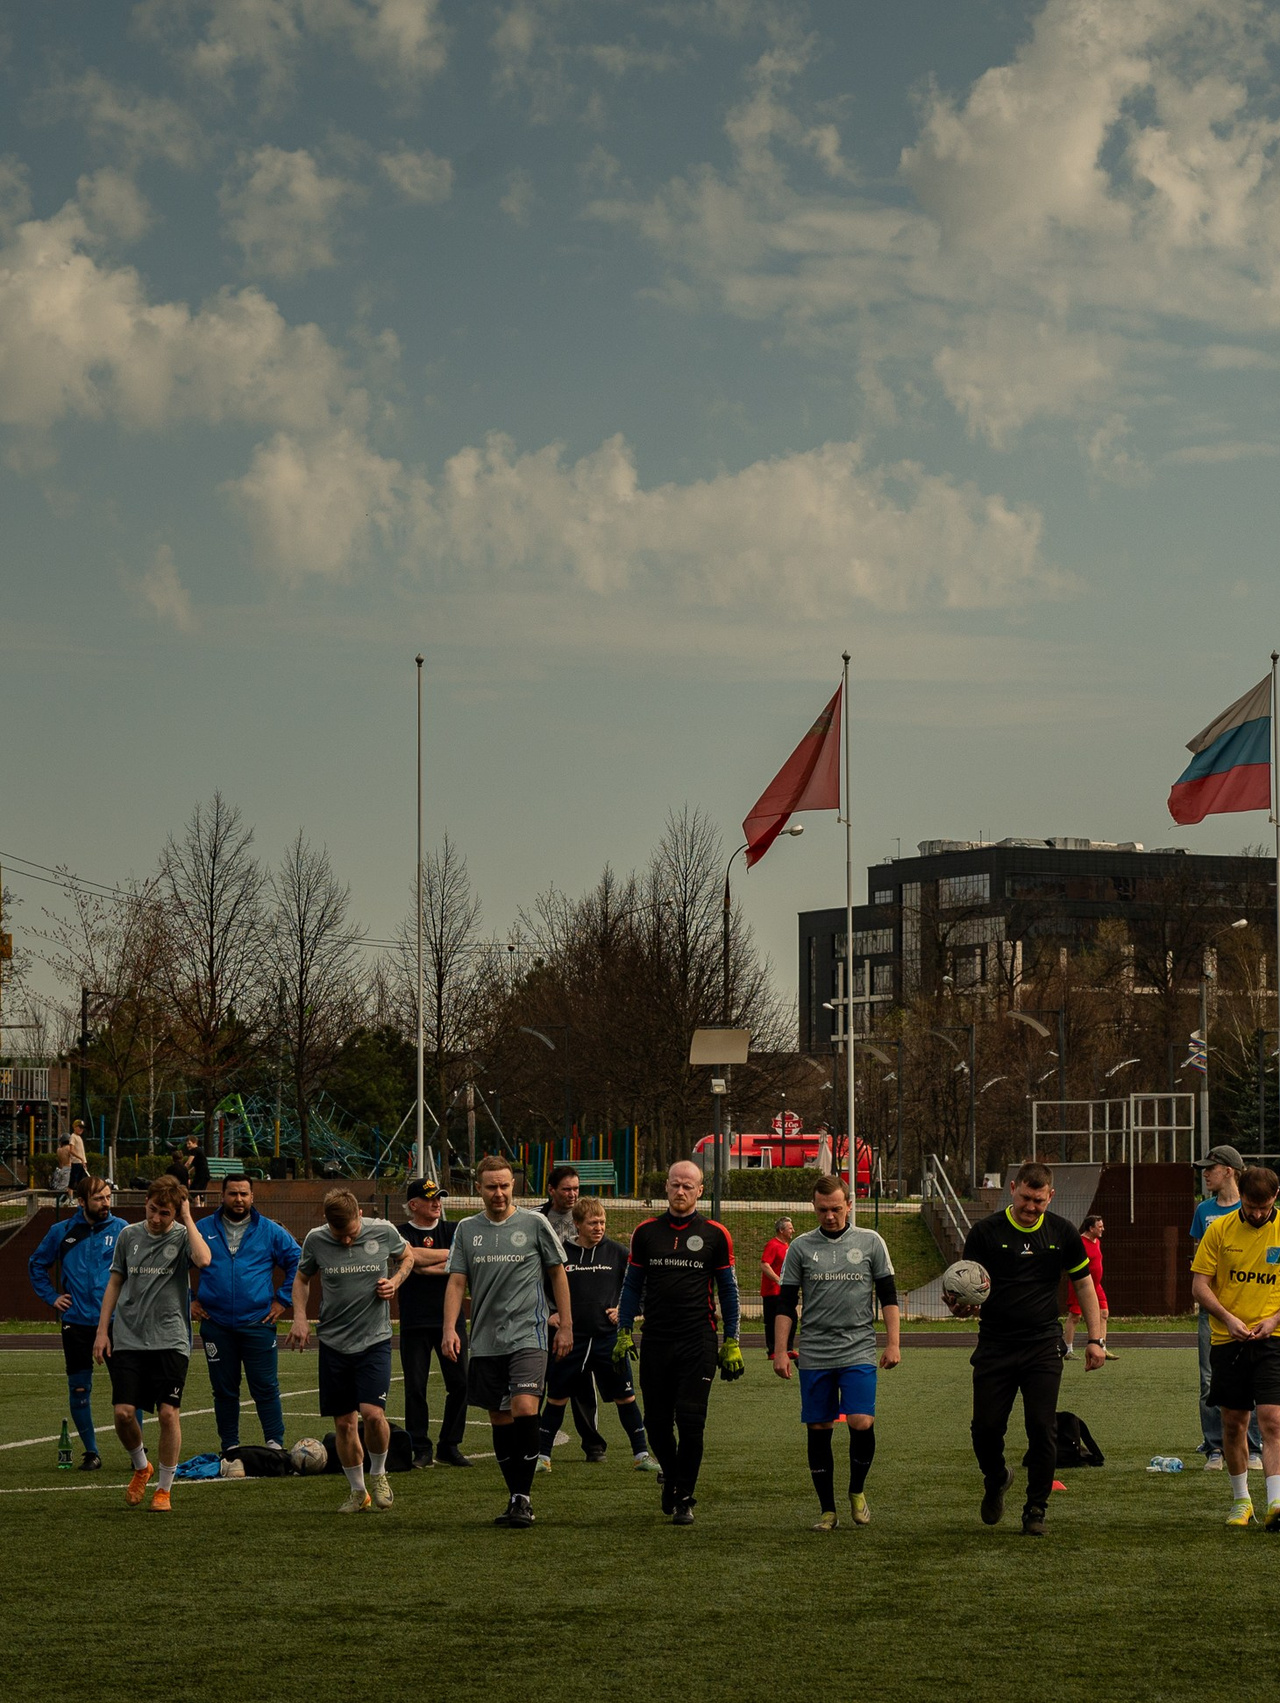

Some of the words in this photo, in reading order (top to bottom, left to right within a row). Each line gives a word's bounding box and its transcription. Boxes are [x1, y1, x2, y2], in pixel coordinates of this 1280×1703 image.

[472, 1235, 483, 1247] 82
[133, 1244, 139, 1255] 9
[486, 1254, 525, 1263] ВНИИССОК
[812, 1251, 819, 1263] 4
[340, 1264, 381, 1274] ВНИИССОК
[565, 1264, 613, 1273] Champion
[664, 1258, 705, 1269] ВНИИССОК
[824, 1272, 865, 1281] ВНИИССОК
[1230, 1269, 1277, 1285] ГОРКИ
